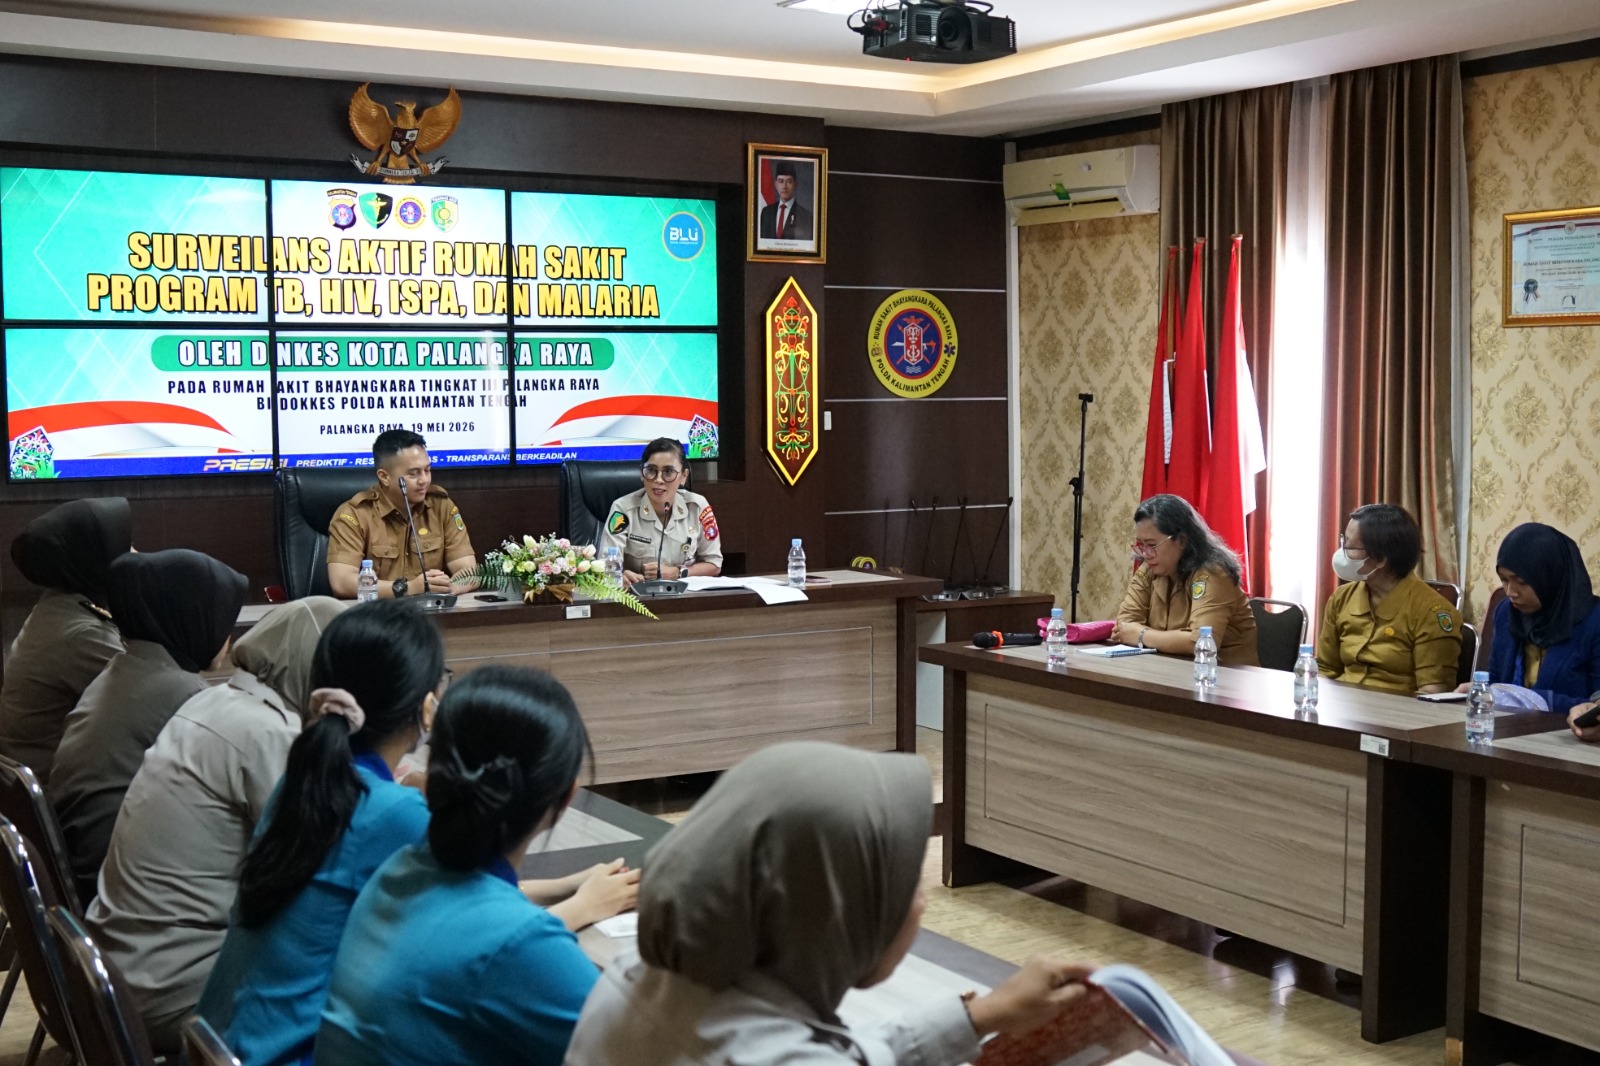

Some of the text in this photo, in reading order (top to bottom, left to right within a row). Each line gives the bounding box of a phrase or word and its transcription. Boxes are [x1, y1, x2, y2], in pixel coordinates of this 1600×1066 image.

[669, 226, 698, 241] BLU
[128, 231, 627, 281] SURVEILANS AKTIF RUMAH SAKIT
[87, 273, 258, 314] PROGRAM
[320, 278, 383, 317] HIV,
[389, 279, 467, 318] ISPA,
[474, 280, 531, 318] DAN
[538, 283, 661, 320] MALARIA
[873, 295, 953, 340] RUMAH SAKIT BHAYANGKARA PALANGKA RAYA
[178, 340, 243, 367] OLEH
[251, 340, 340, 367] DNKES
[348, 341, 410, 367] KOTA
[540, 342, 593, 367] RAYA
[876, 358, 950, 392] POLDA KALIMANTAN TENGAH
[168, 380, 207, 395] PADA
[213, 380, 265, 394] RUMAH
[275, 380, 309, 394] AKIT
[315, 379, 417, 394] BHAYANGKARA
[421, 379, 477, 393] TINGKAT
[503, 378, 565, 392] PLANGKA
[570, 378, 599, 391] RAYA
[257, 396, 335, 411] BIDOKKES
[341, 396, 385, 410] POLDA
[390, 395, 475, 409] KALIMANTAN
[320, 424, 375, 435] PALANGKA
[412, 422, 423, 433] 19
[427, 422, 445, 432] MEI
[449, 421, 475, 432] 2026
[296, 458, 348, 467] PREDIKTIF
[446, 454, 511, 463] TRANSPARANS
[516, 452, 577, 461] BERKEADILAN
